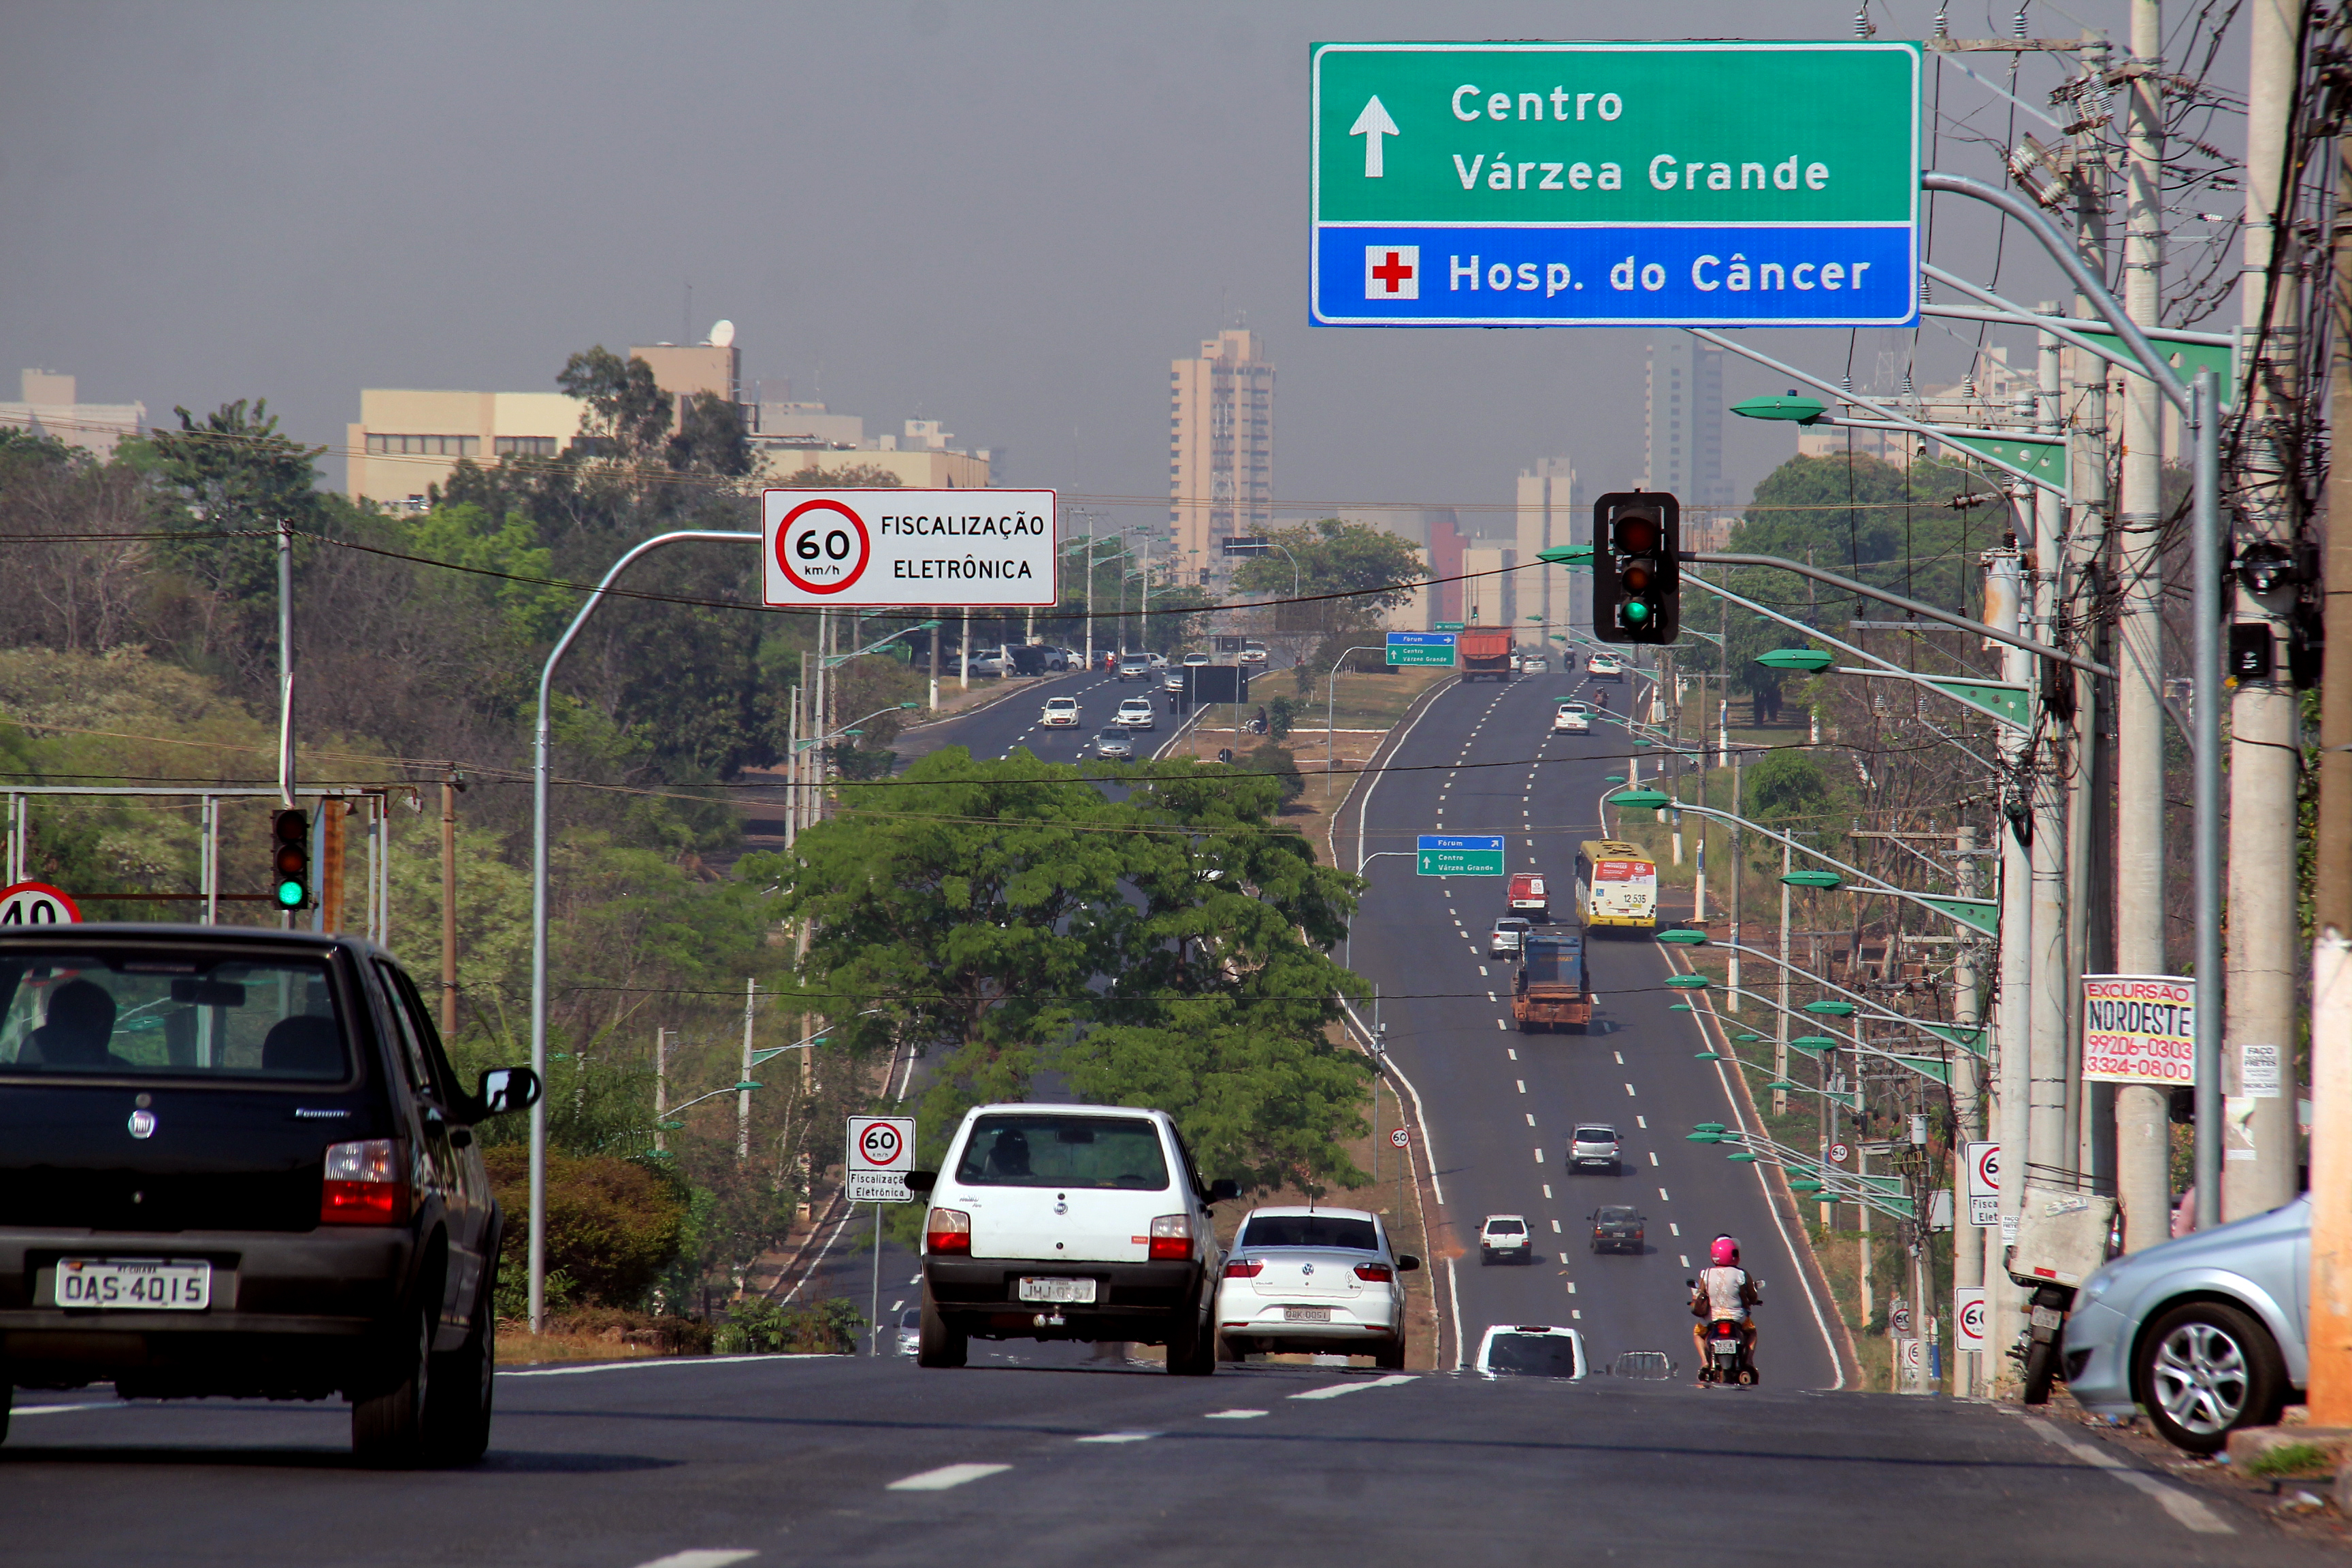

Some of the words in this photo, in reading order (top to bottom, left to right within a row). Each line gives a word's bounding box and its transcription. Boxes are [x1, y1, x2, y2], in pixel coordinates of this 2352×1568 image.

[1452, 84, 1623, 122] Centro
[1452, 152, 1622, 191] Várzea
[1648, 153, 1831, 191] Grande
[1450, 254, 1585, 299] Hosp.
[1610, 255, 1667, 292] do
[1691, 252, 1872, 292] Câncer
[881, 510, 1045, 540] FISCALIZAÇÃO
[796, 529, 850, 560] 60
[804, 565, 840, 576] km/h
[894, 554, 1032, 579] ELETRÔNICA
[1624, 894, 1631, 902] 12
[1633, 894, 1646, 903] 535
[2087, 983, 2189, 1002] EXCURSÃO
[2089, 1000, 2192, 1036] NORDESTE
[2088, 1034, 2193, 1060] 99206-0303
[2087, 1056, 2191, 1080] 3324-0800
[865, 1132, 895, 1149] 60
[1393, 1132, 1407, 1141] 60
[1832, 1147, 1845, 1156] 60
[1985, 1157, 1999, 1174] 6
[851, 1173, 904, 1186] Fiscalizaçã
[857, 1188, 904, 1196] Eletrônica
